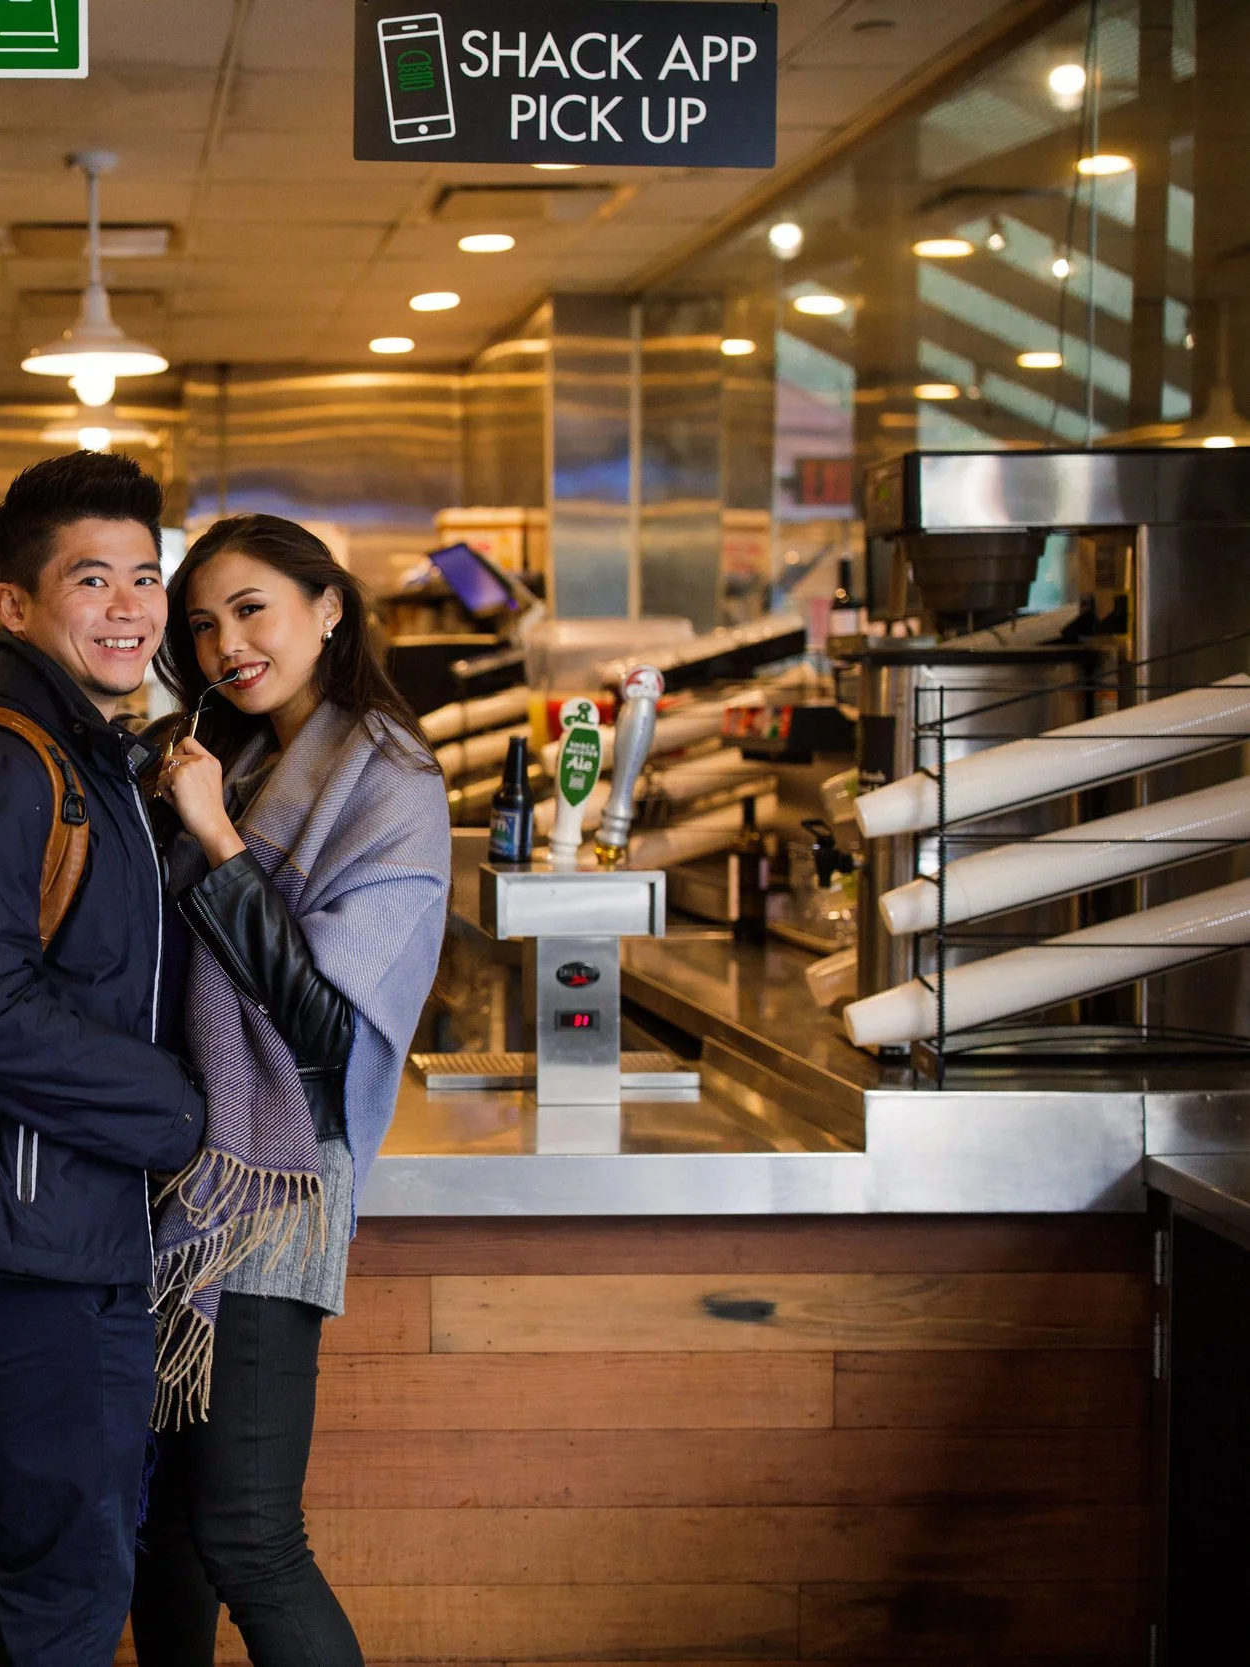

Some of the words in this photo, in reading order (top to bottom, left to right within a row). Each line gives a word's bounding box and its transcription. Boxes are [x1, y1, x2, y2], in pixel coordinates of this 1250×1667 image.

[459, 29, 644, 81] SHACK
[657, 34, 757, 82] APP
[510, 93, 624, 143] PICK
[641, 96, 707, 144] UP
[565, 755, 593, 772] Ale
